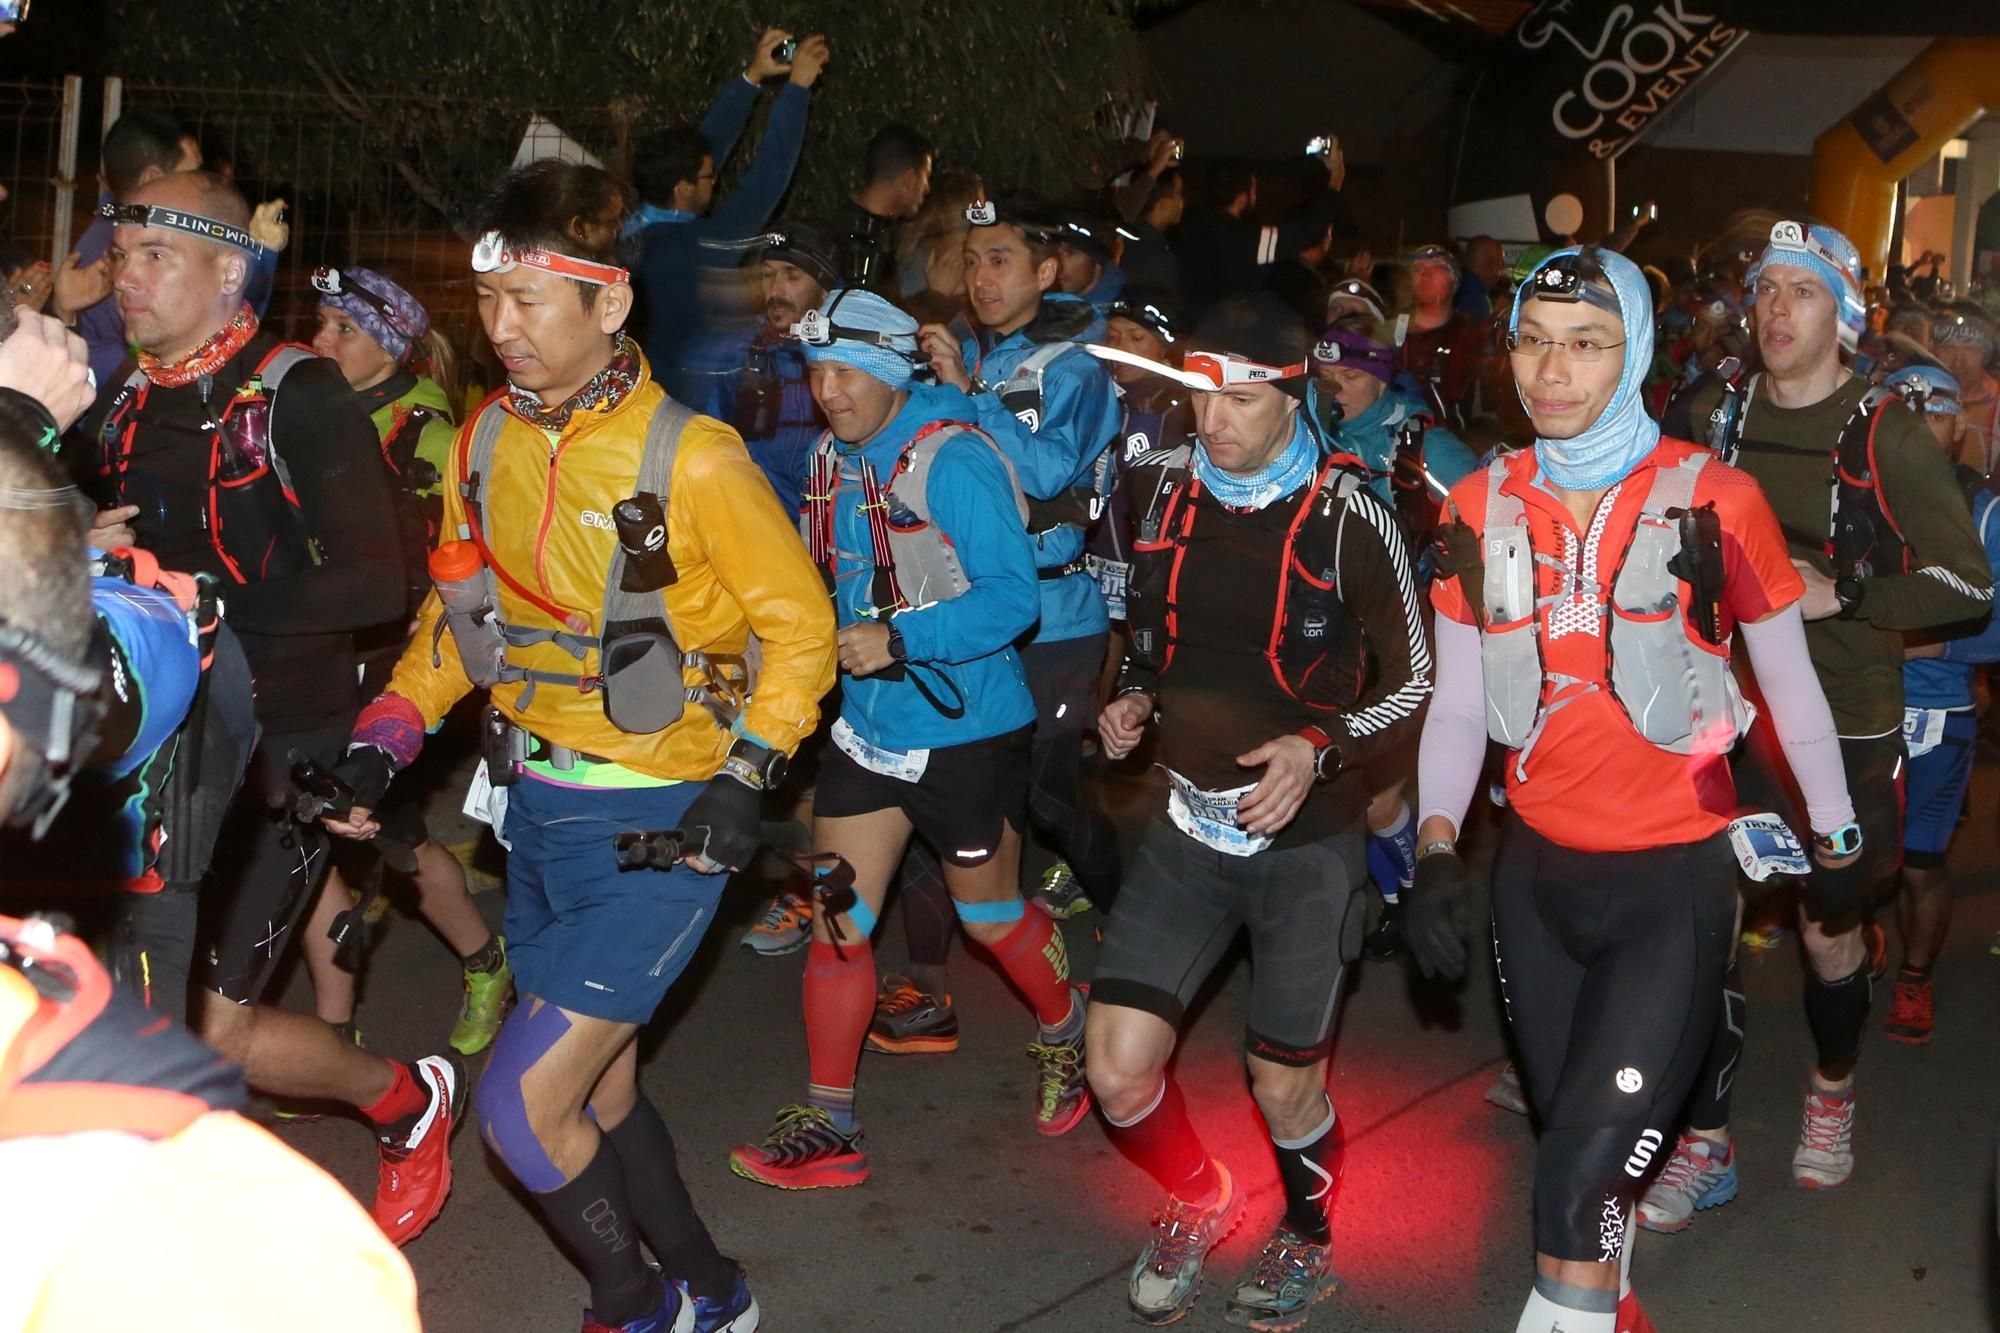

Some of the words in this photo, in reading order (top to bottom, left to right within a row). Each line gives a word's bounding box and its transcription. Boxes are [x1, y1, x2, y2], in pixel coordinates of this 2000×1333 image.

[1553, 0, 1716, 139] COOK
[1616, 22, 1737, 131] EVENTS
[1249, 370, 1268, 379] PETZL
